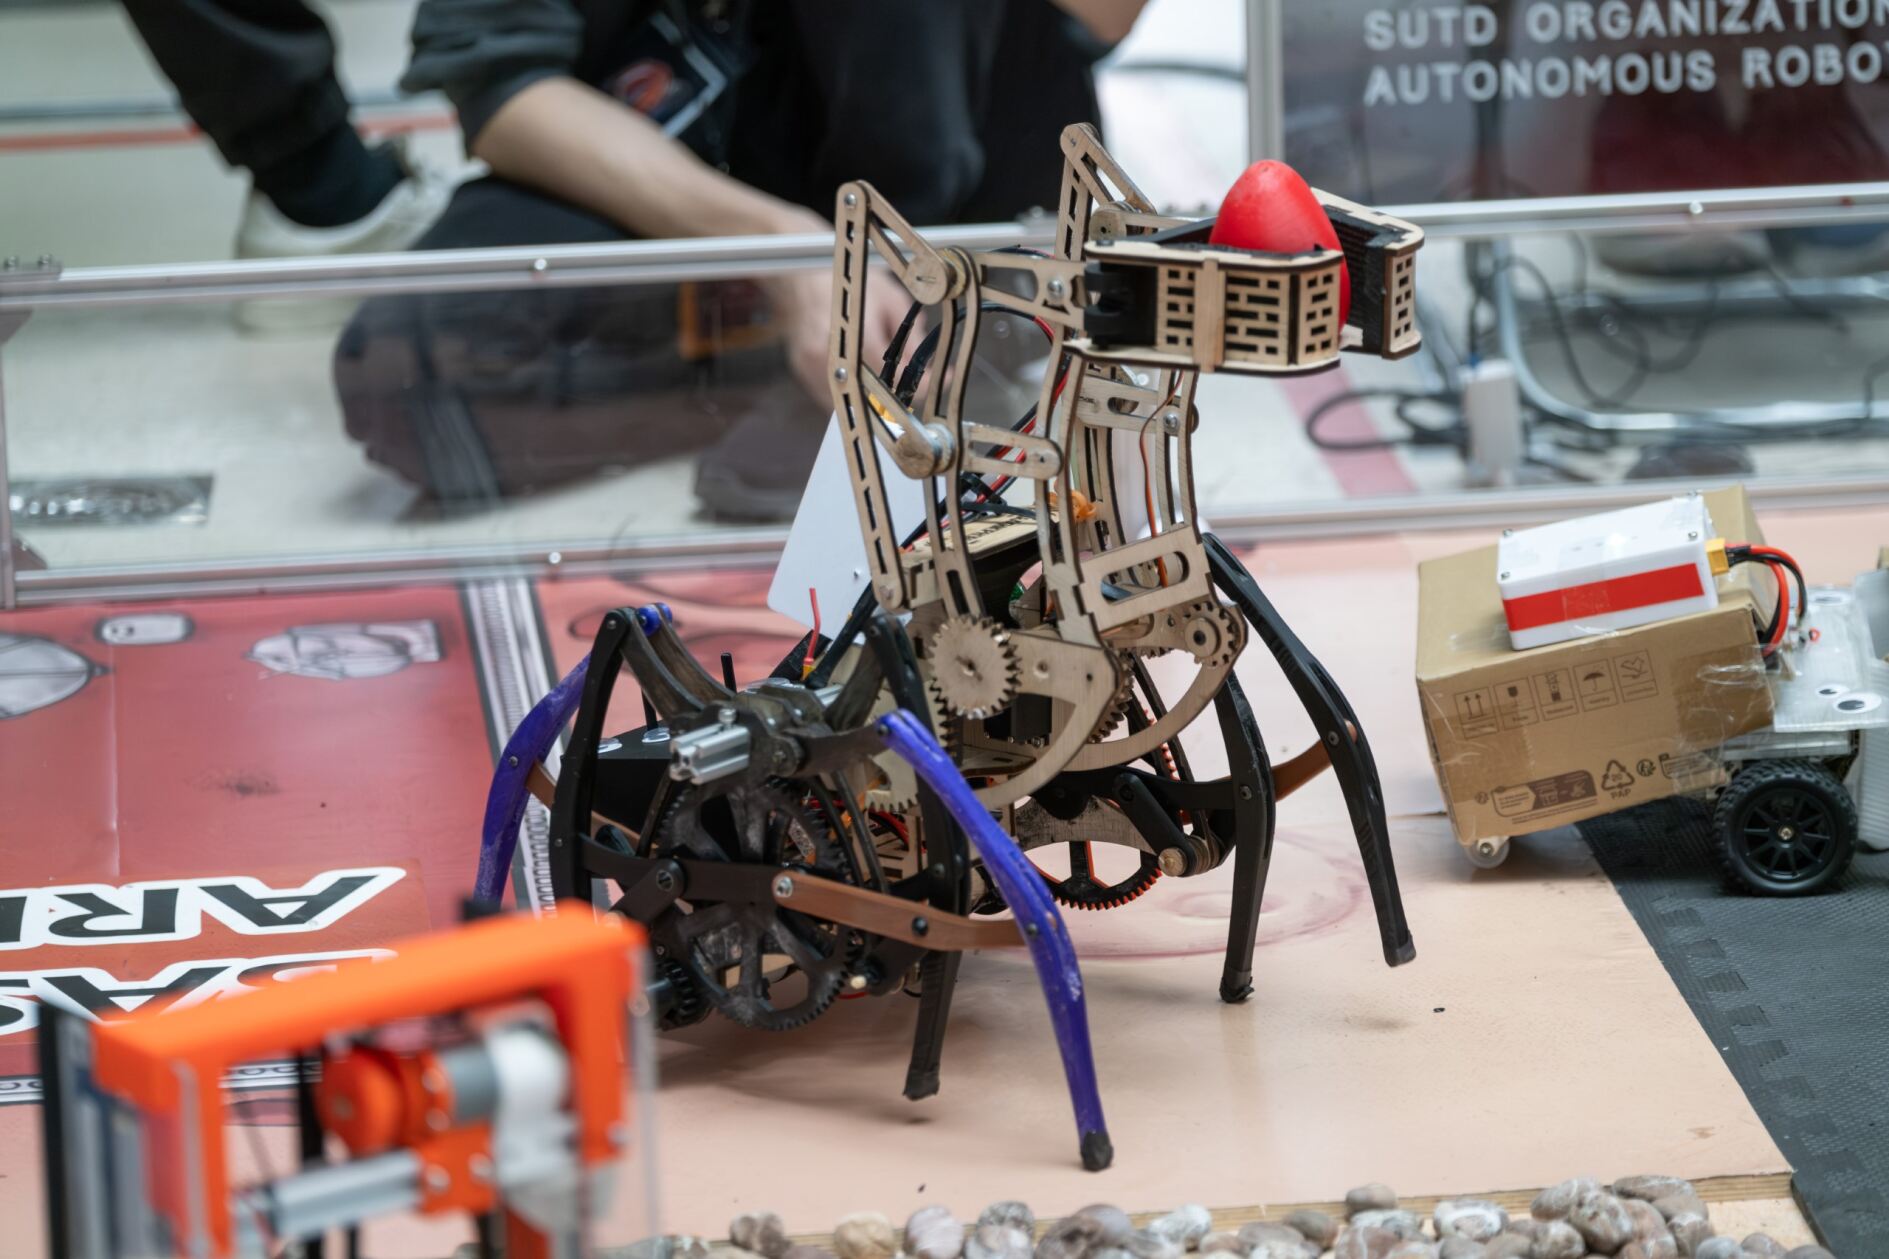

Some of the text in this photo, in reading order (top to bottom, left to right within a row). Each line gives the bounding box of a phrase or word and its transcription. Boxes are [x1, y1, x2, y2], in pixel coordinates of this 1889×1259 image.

[1363, 5, 1497, 50] SUTD
[1363, 40, 1889, 106] AUTONOMOUS ROBO
